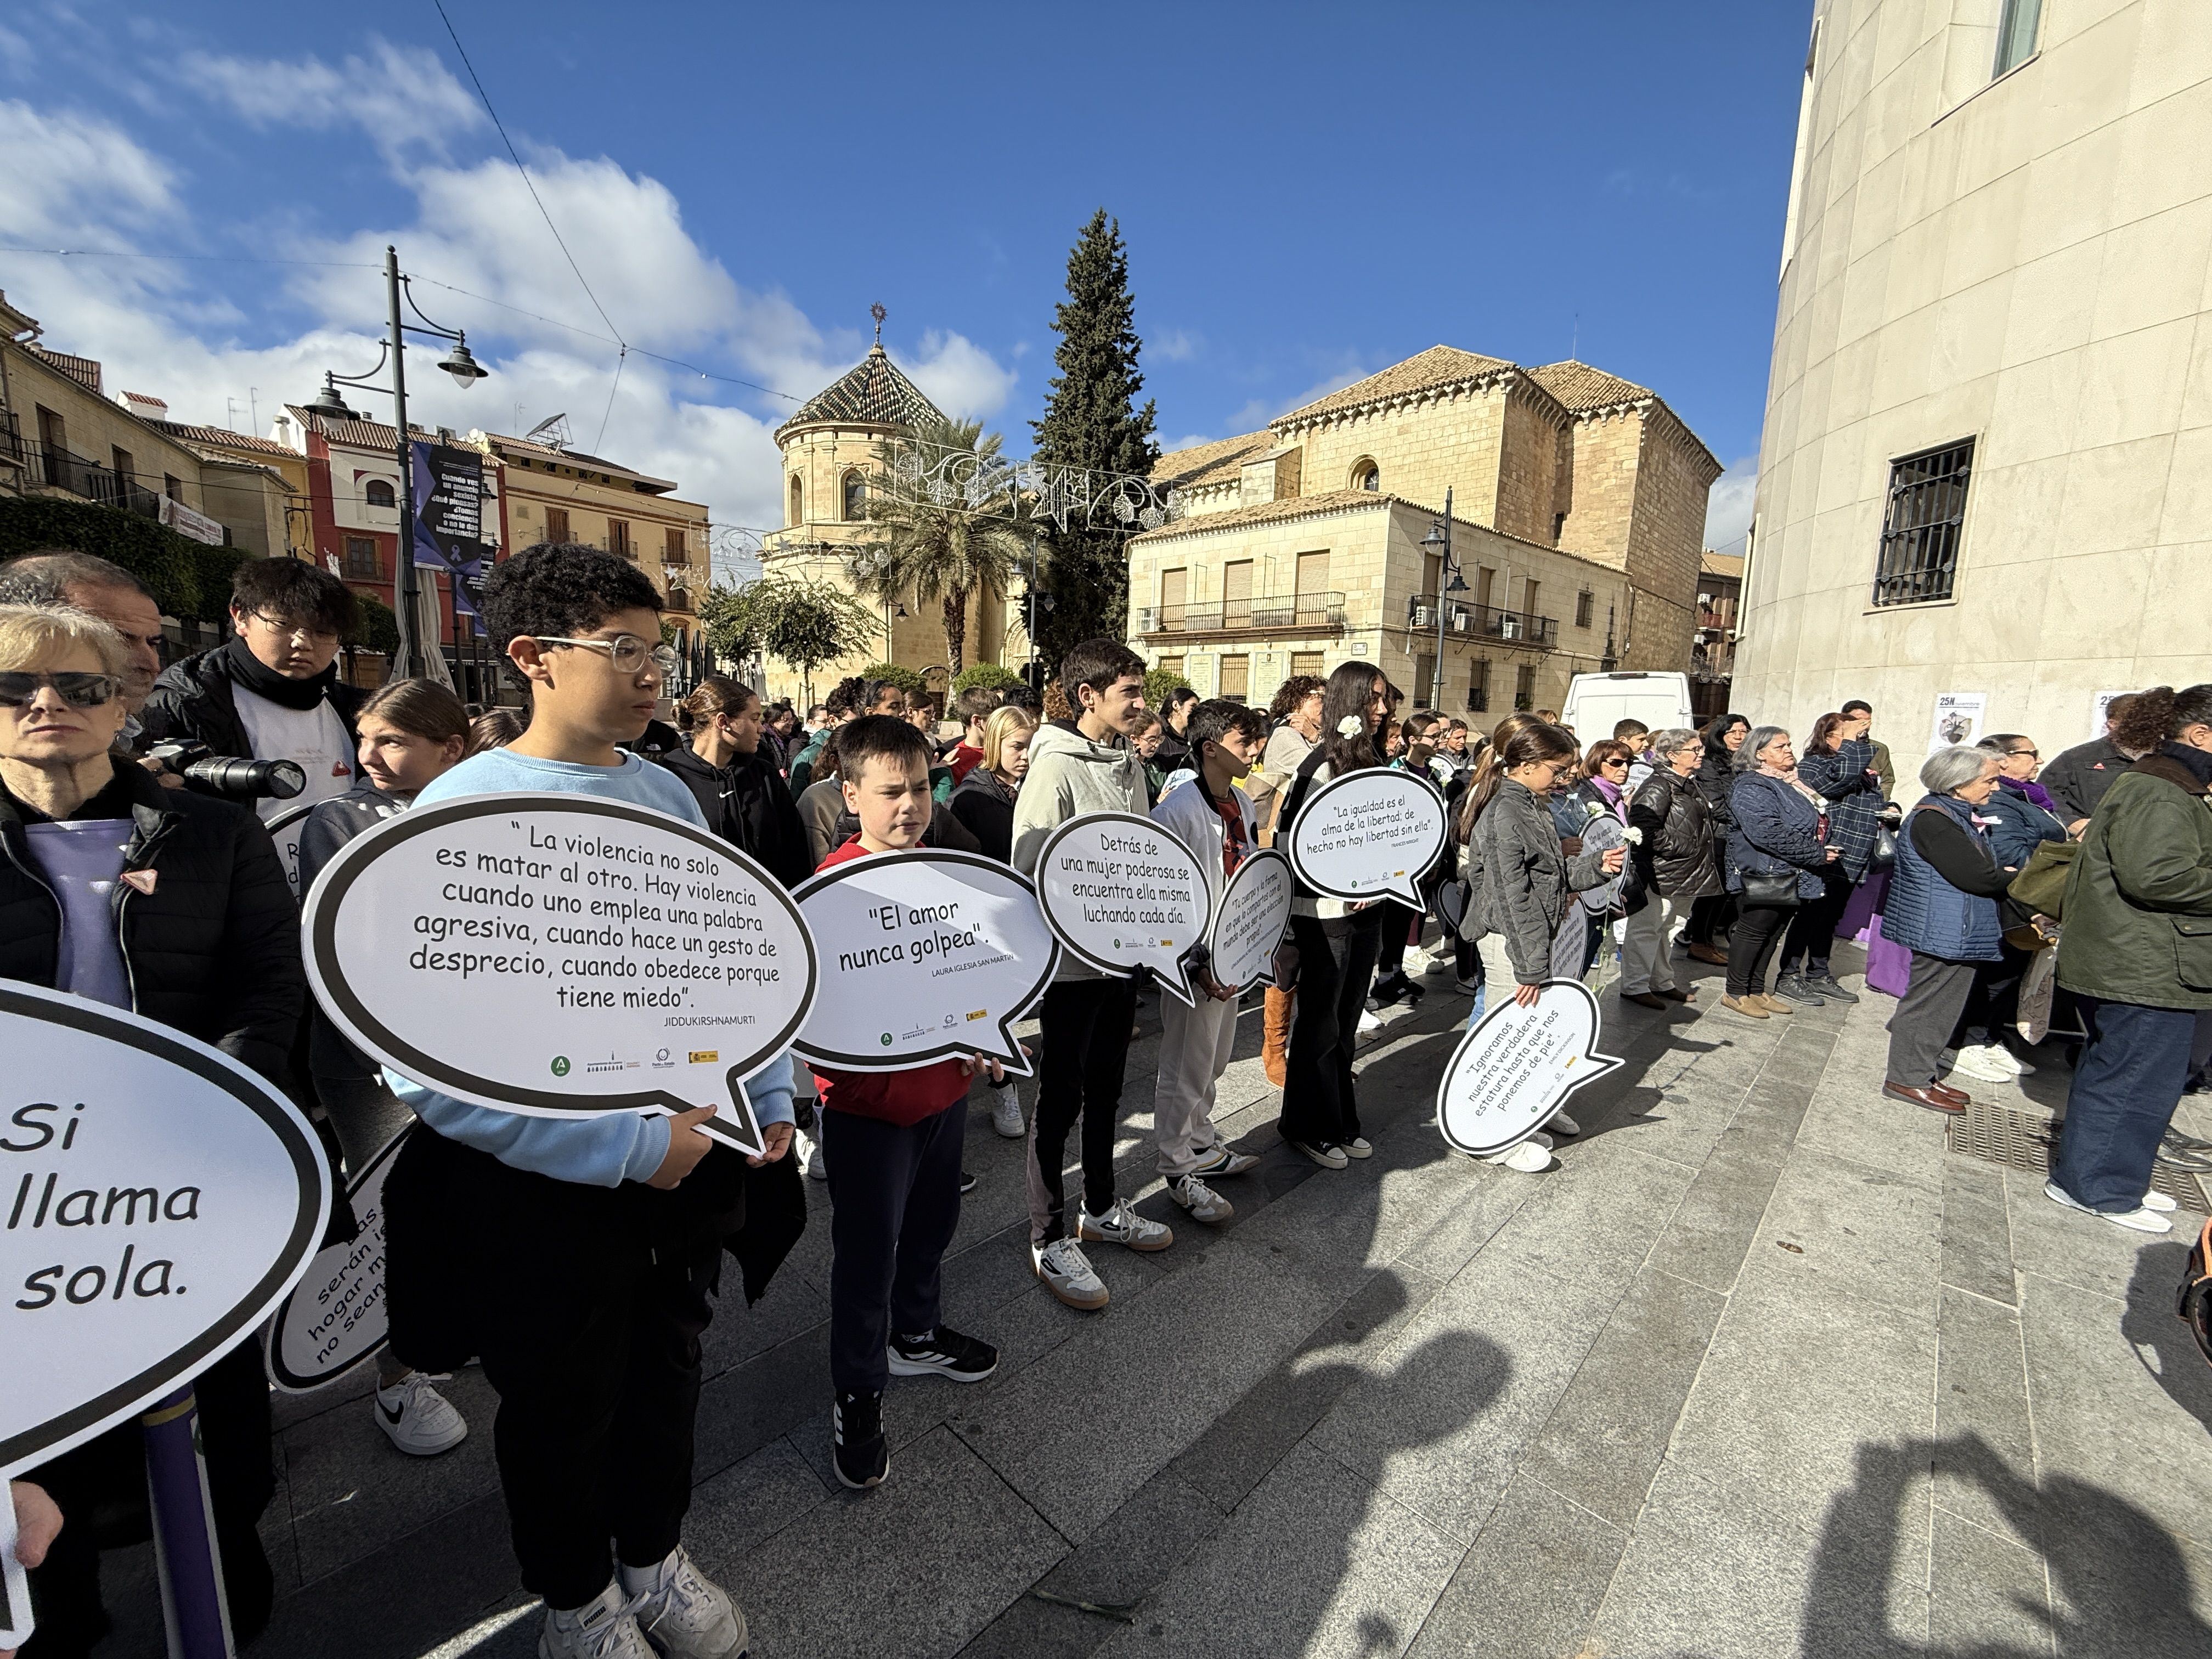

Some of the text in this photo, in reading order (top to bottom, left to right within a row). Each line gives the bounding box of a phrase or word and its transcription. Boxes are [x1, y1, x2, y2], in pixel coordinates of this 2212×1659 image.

[442, 473, 466, 484] Cuando
[453, 484, 478, 494] anuncio
[431, 495, 478, 509] ¿Qué piensas?
[454, 506, 478, 516] ¿Tomas
[436, 524, 478, 538] importancia?
[443, 512, 478, 524] conciencia
[1334, 794, 1404, 818] "La igualdad es el
[1322, 823, 1342, 836] alma
[1345, 820, 1355, 831] de
[1358, 818, 1365, 829] la
[1405, 809, 1414, 820] de
[1101, 833, 1158, 855] Detrás de
[1307, 840, 1333, 854] hecho
[1336, 840, 1346, 848] no
[1349, 835, 1363, 847] hay
[1366, 826, 1398, 842] libertad
[1402, 824, 1412, 835] sin
[565, 834, 654, 866] violencia
[661, 854, 680, 870] no
[686, 856, 719, 876] solo
[1061, 857, 1189, 881] una mujer poderosa se
[436, 849, 757, 906] es matar al otro. Hay violencia
[1232, 872, 1277, 910] "Tu cuerpo y la forma
[1073, 883, 1190, 902] encuentra ella misma
[1226, 922, 1231, 933] en
[1242, 909, 1245, 919] lo
[1247, 892, 1268, 915] compartes
[1278, 880, 1281, 891] el
[443, 883, 763, 932] cuando uno emplea una palabra
[869, 903, 958, 930] "El amor
[1084, 904, 1186, 924] luchando cada día.
[1223, 930, 1238, 951] mundo
[1239, 922, 1250, 936] debe
[1267, 893, 1283, 913] elección
[414, 916, 776, 958] agresiva, cuando hace un gesto de
[410, 944, 780, 986] desprecio, cuando obedece porque
[839, 945, 904, 972] nunca
[932, 953, 1014, 977] LAURA IGLESIA SAN MARTÍN
[556, 985, 693, 1008] tiene miedo".
[663, 1015, 755, 1027] JIDDUKIRSHNAMURTI
[1466, 1023, 1515, 1076] "Ignoramos
[1469, 1015, 1538, 1102] nuestra verdadera
[1476, 1011, 1558, 1116] estatura hasta que nos
[1497, 1068, 1530, 1111] ponemos
[1529, 1056, 1541, 1068] de
[0, 1103, 85, 1152] Si
[7, 1172, 201, 1229] llama
[15, 1244, 187, 1310] sola.
[318, 1244, 371, 1305] serán
[308, 1277, 363, 1341] hogar
[317, 1336, 339, 1364] no
